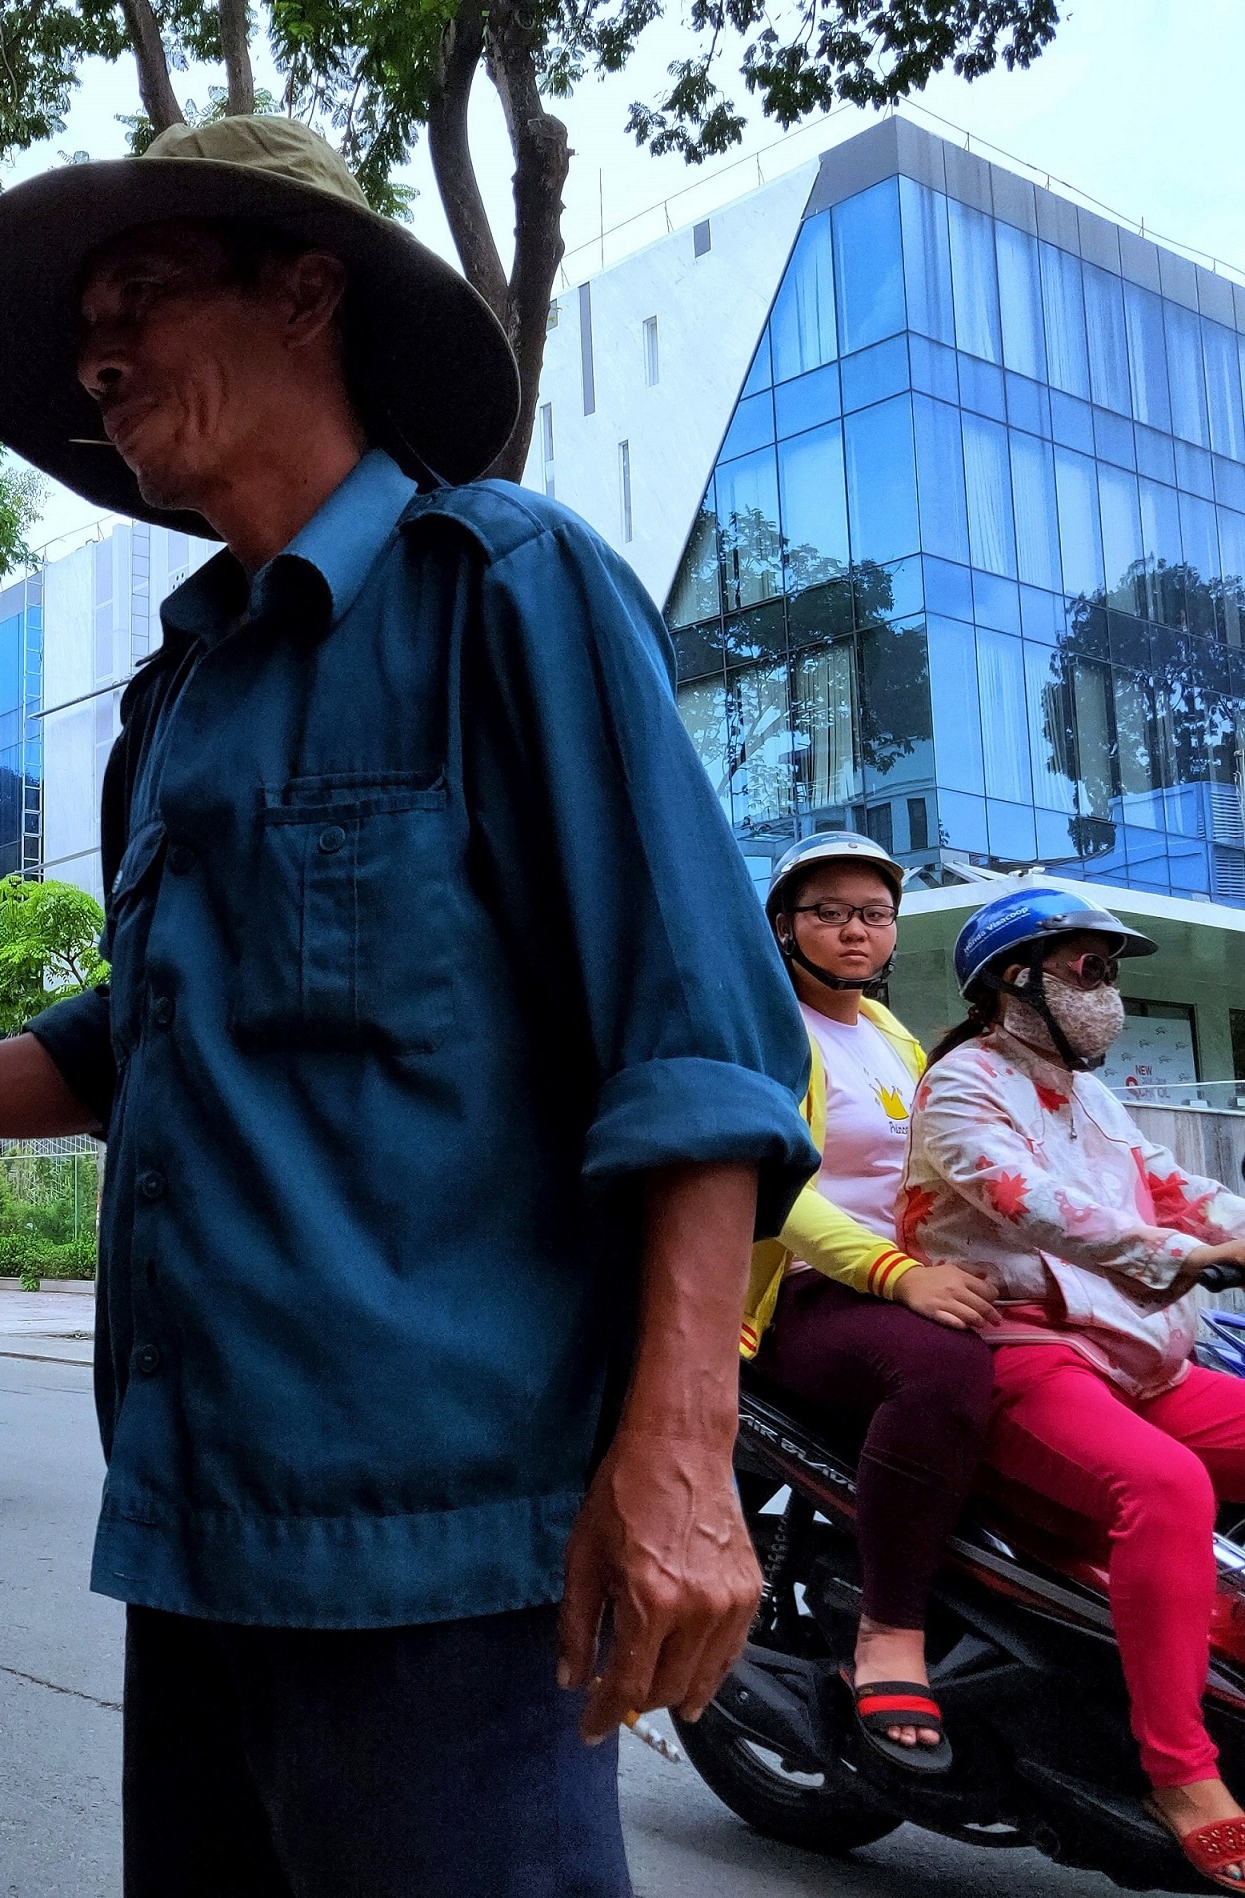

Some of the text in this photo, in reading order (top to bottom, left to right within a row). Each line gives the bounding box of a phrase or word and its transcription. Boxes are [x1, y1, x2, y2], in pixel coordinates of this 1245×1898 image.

[963, 906, 1029, 954] Honda Visacoop
[1135, 1064, 1153, 1076] NEW
